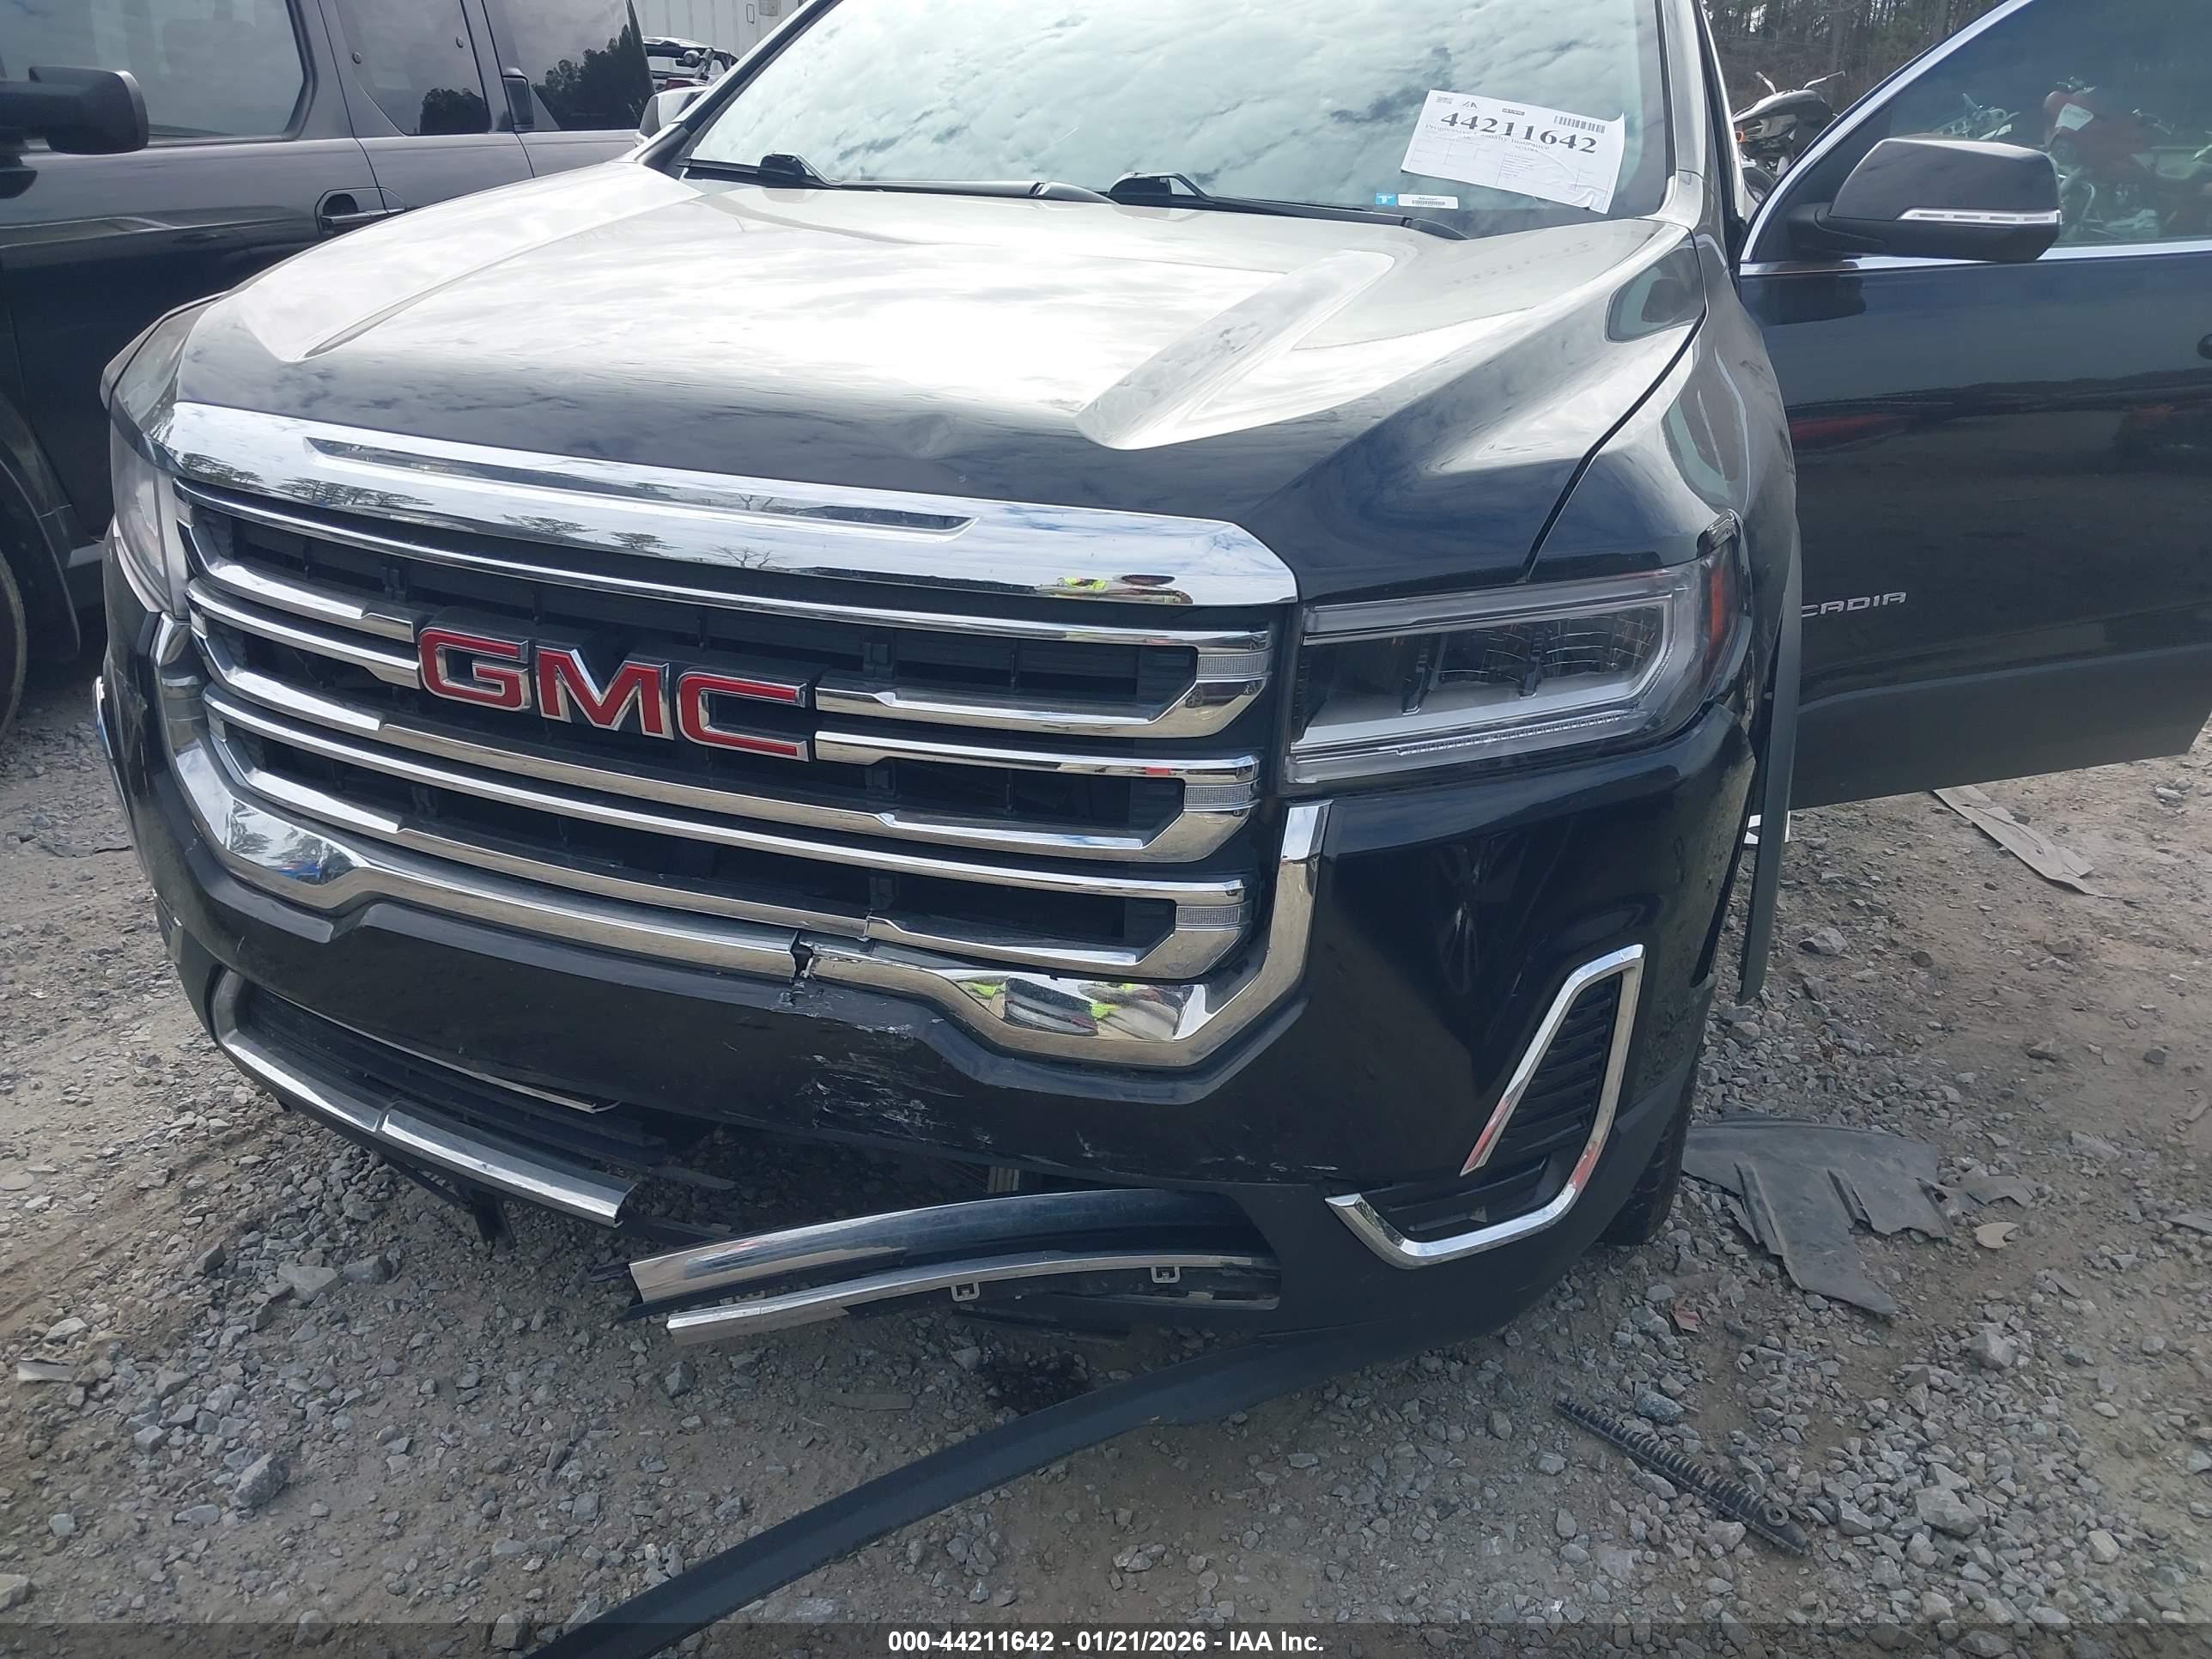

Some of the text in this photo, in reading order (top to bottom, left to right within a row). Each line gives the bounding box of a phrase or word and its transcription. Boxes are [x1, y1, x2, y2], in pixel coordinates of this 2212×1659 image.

[1440, 112, 1597, 154] 44211642
[1802, 592, 1907, 617] CADIA
[418, 627, 810, 763] GMC
